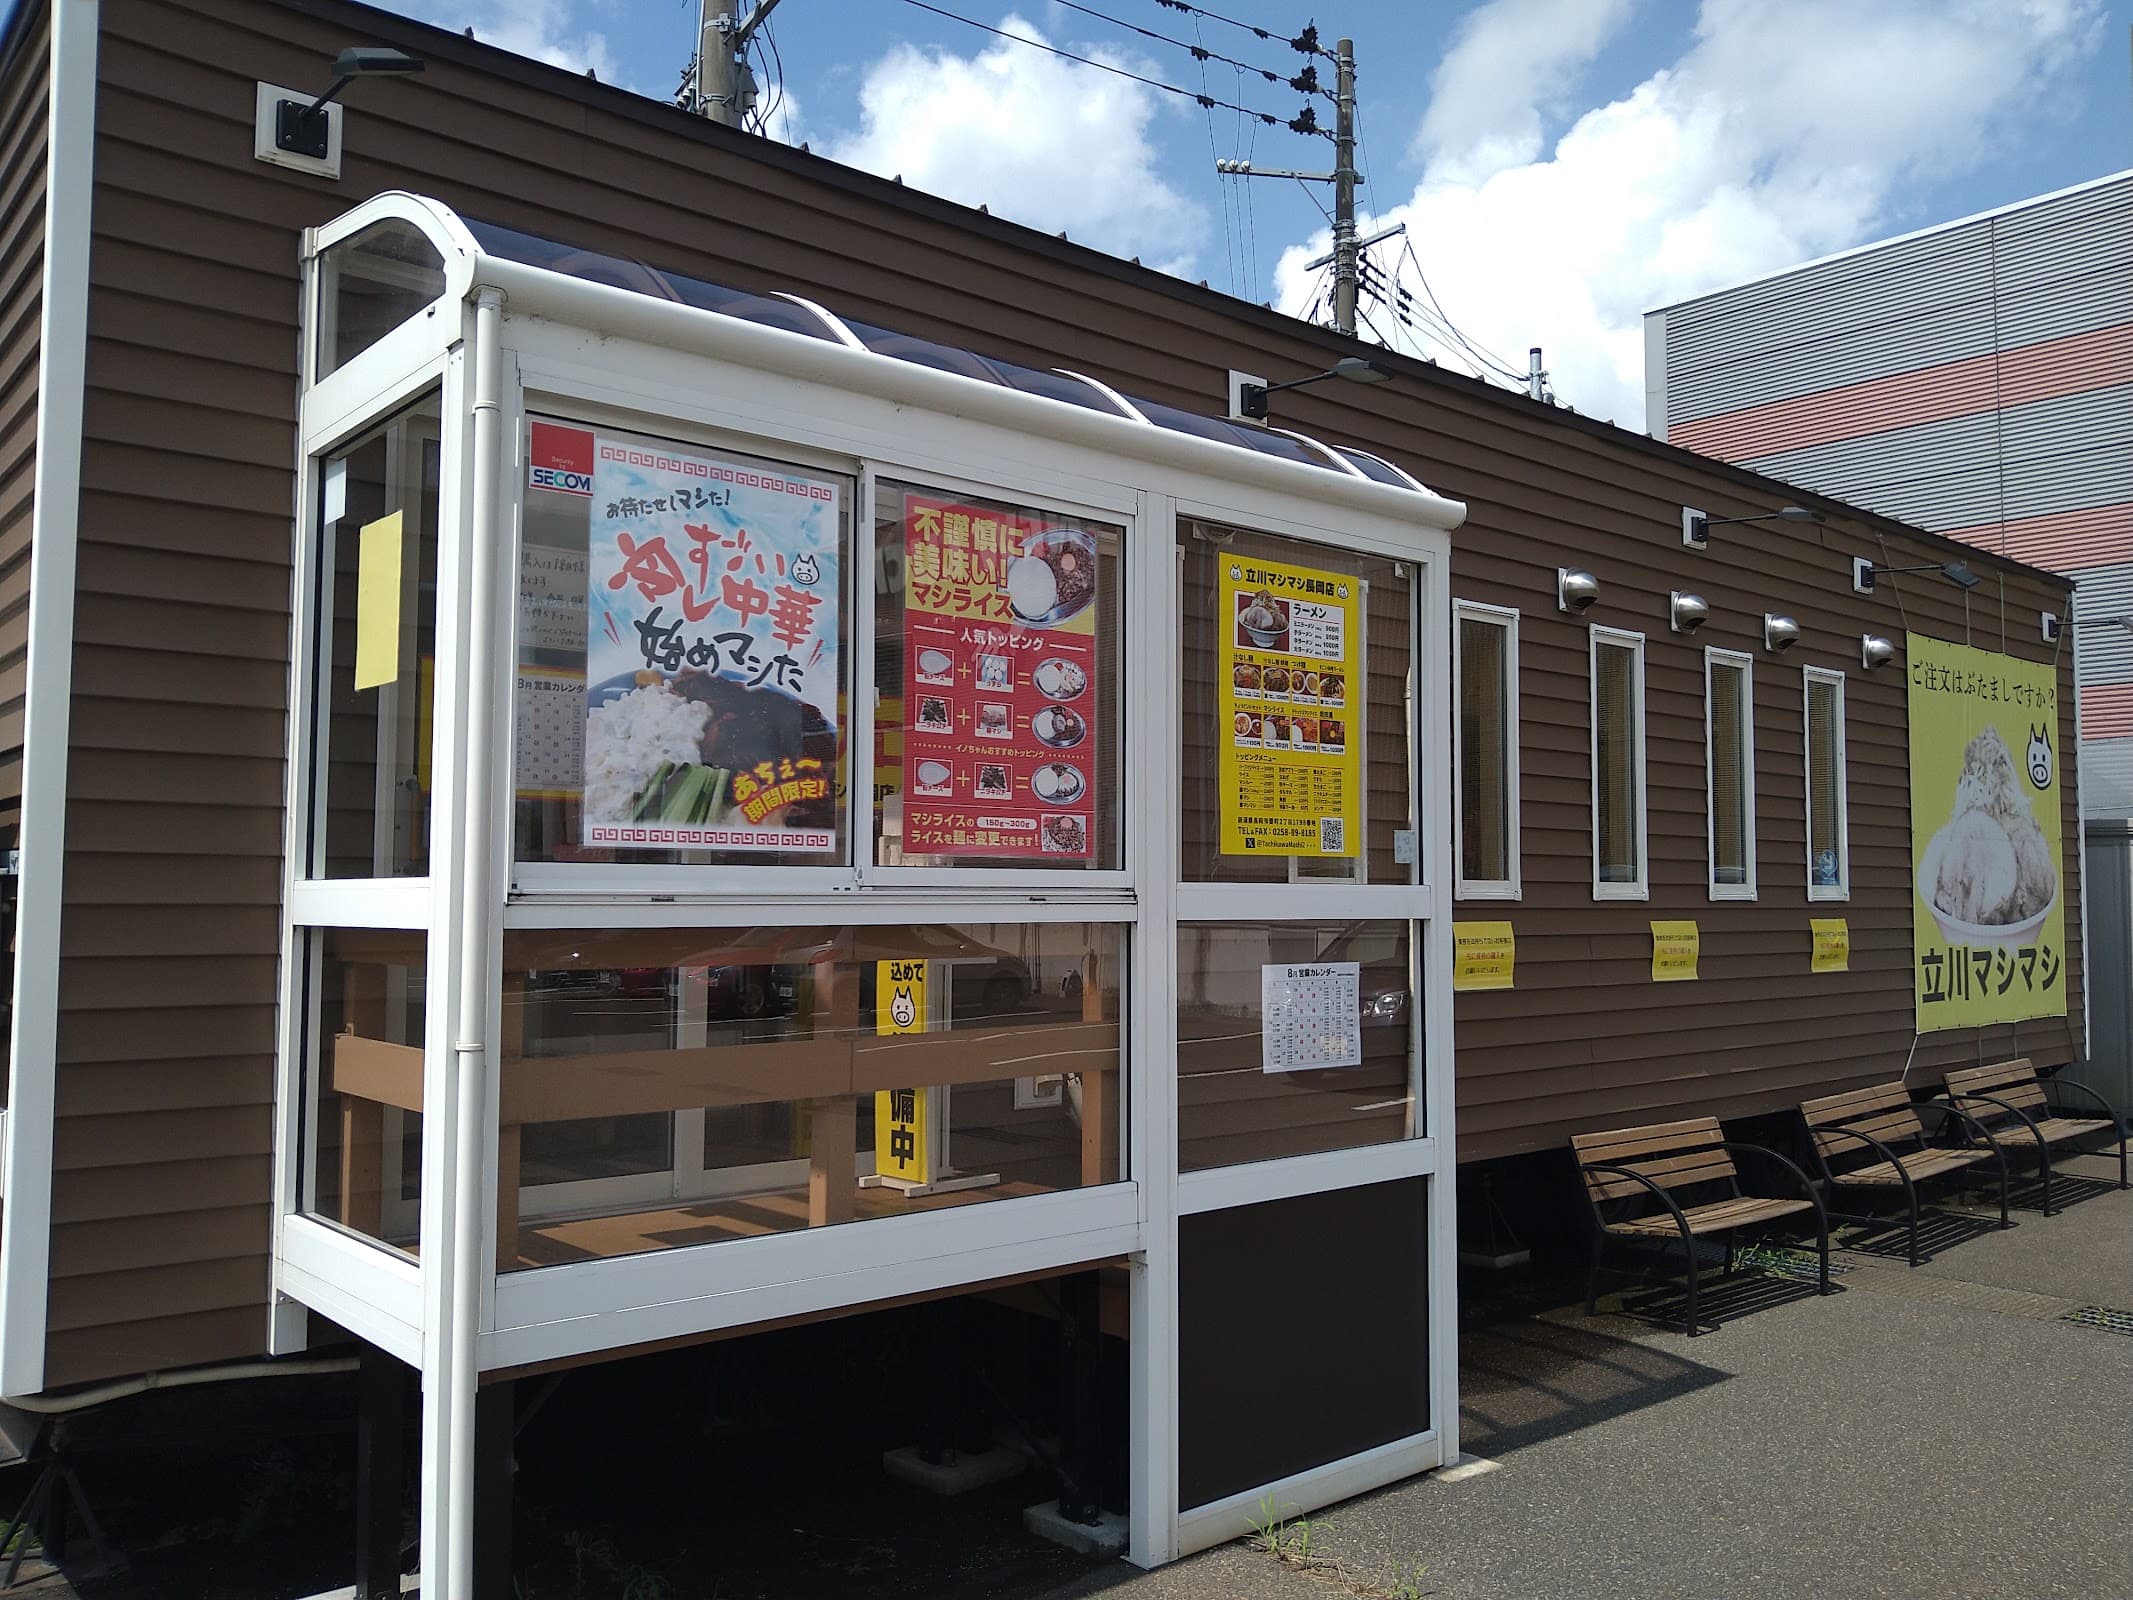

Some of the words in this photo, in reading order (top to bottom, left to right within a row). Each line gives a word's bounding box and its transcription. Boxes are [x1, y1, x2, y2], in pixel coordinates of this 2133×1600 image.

[533, 468, 590, 491] SECOM
[913, 505, 1024, 557] 不謹慎に
[684, 523, 785, 595] すごい
[608, 532, 823, 651] 冷し中華
[911, 581, 1015, 619] マシライス
[1245, 568, 1335, 597] 立川マシマシ長岡店
[1293, 603, 1327, 619] ラーメン
[634, 606, 804, 692] 始めマシた
[960, 627, 1043, 650] 人気トッピング
[1912, 659, 2055, 709] ご注文はぶたましですか?
[911, 812, 975, 826] マシライスの
[890, 962, 924, 982] 込めて
[1921, 943, 2060, 1004] 立川マシマシ
